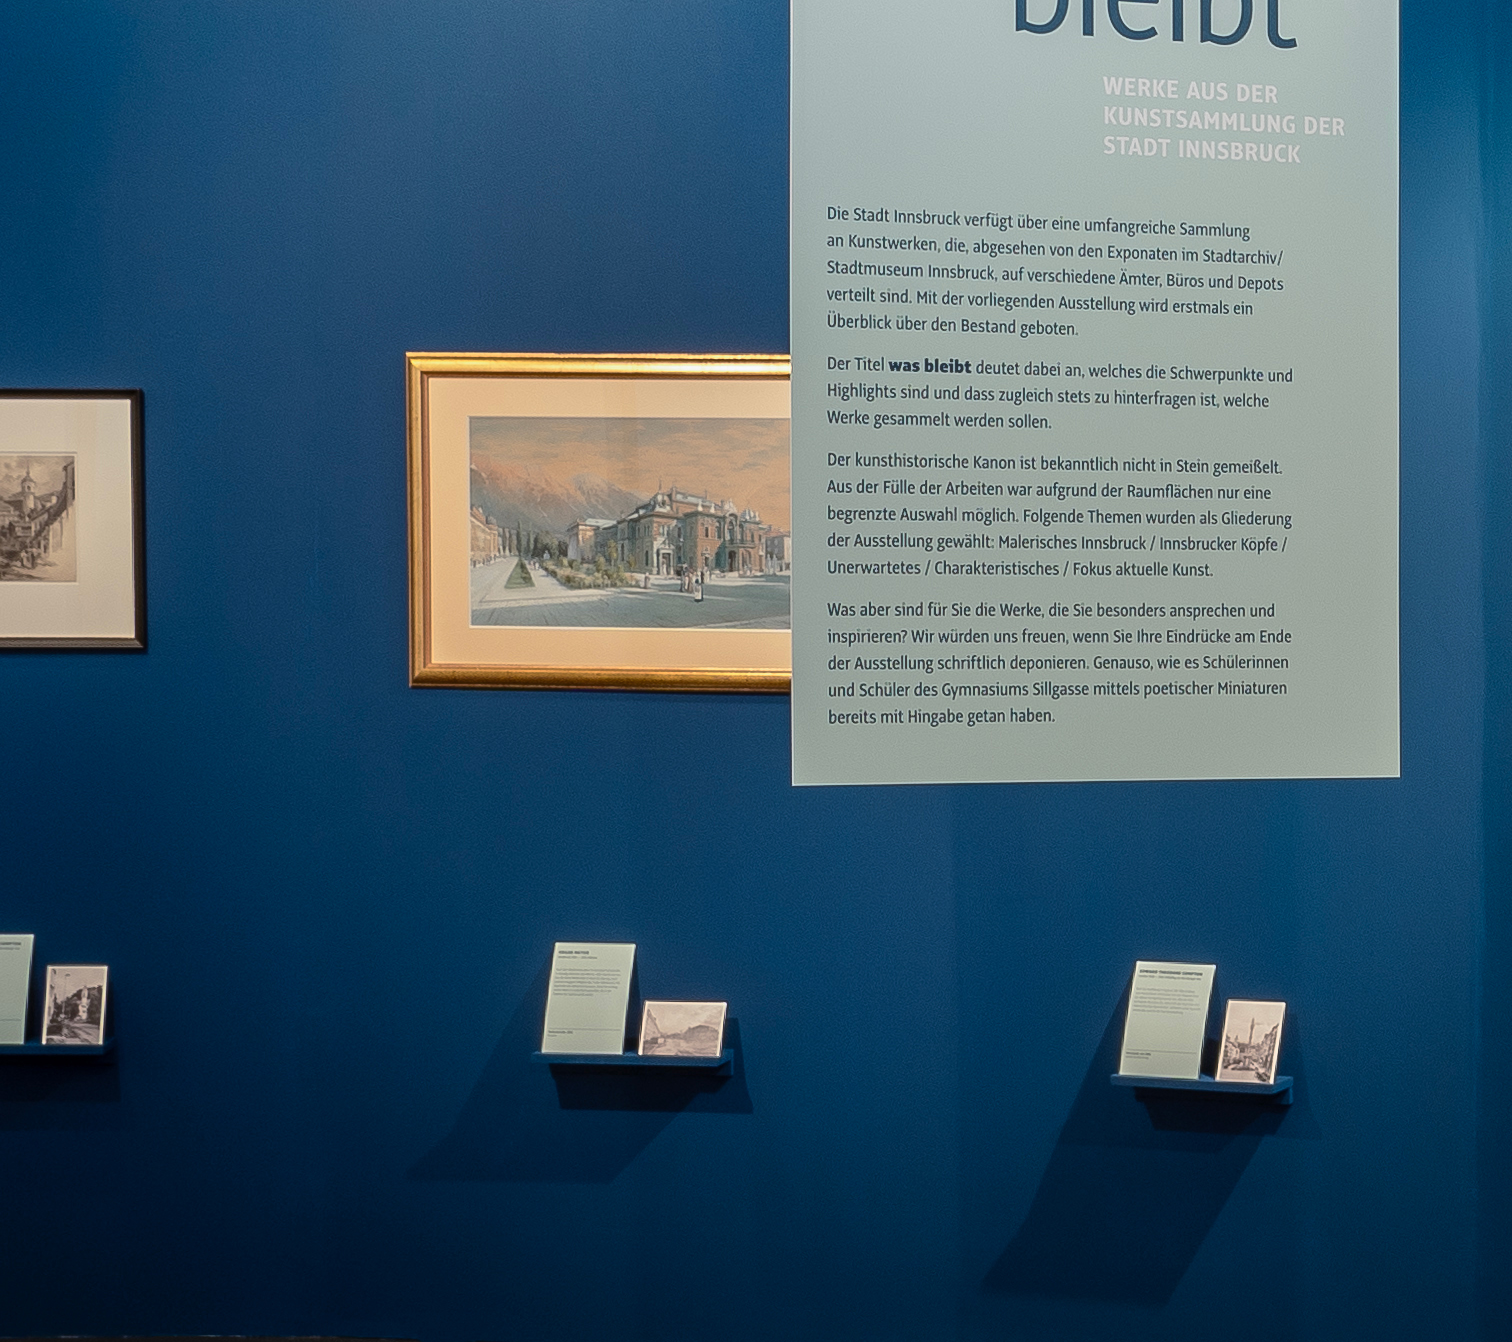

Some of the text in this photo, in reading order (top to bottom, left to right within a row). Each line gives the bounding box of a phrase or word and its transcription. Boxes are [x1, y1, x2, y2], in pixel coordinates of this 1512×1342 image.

[1103, 76, 1278, 104] WERKE AUS DER
[1103, 105, 1346, 136] KUNSTSAMMLUNG DER
[1103, 135, 1301, 164] STADT INNSBRUCK
[827, 205, 1251, 242] Die Stadt Innsbruck verfügt über eine umfangreiche Sammlung
[826, 234, 1284, 266] an Kunstwerken, die, abgesehen von den Exponaten im Stadtarchiv/
[826, 259, 1285, 294] Stadtmuseum Innsbruck, auf verschiedene Ämter, Büros und Depots
[826, 286, 1254, 316] verteilt sind. Mit der vorliegenden Ausstellung wird erstmals ein
[827, 312, 1079, 339] Überblick über den Bestand geboten.
[827, 356, 1293, 385] Der Titel was bleibt deutet dabei an, welches die Schwerpunkte und
[827, 382, 1270, 410] Highlights sind und dass zugleich stets zu hinterfragen ist, welche
[826, 409, 1053, 430] Werke gesammelt werden sollen.
[827, 451, 1283, 478] Der kunsthistorische Kanon ist bekanntlich nicht in Stein gemeißelt.
[827, 505, 1293, 530] begrenzte Auswahl möglich. Folgende Themen wurden als Gliederung
[827, 532, 1279, 555] der Ausstellung gewählt: Malerisches Innsbruck Innsbrucker Köpfe
[827, 560, 1214, 577] Unerwartetes Charakteristisches Fokus aktuelle Kunst.
[827, 601, 1275, 621] Was aber sind für Sie die Werke, die Sie besonders ansprechen und
[828, 654, 1289, 674] der Ausstellung schriftlich deponieren. Genauso, wie es Schülerinnen
[828, 680, 1288, 701] und Schüler des Gymnasiums Sillgasse mittels poetischer Miniaturen
[828, 707, 1056, 728] bereits mit Hingabe getan haben.
